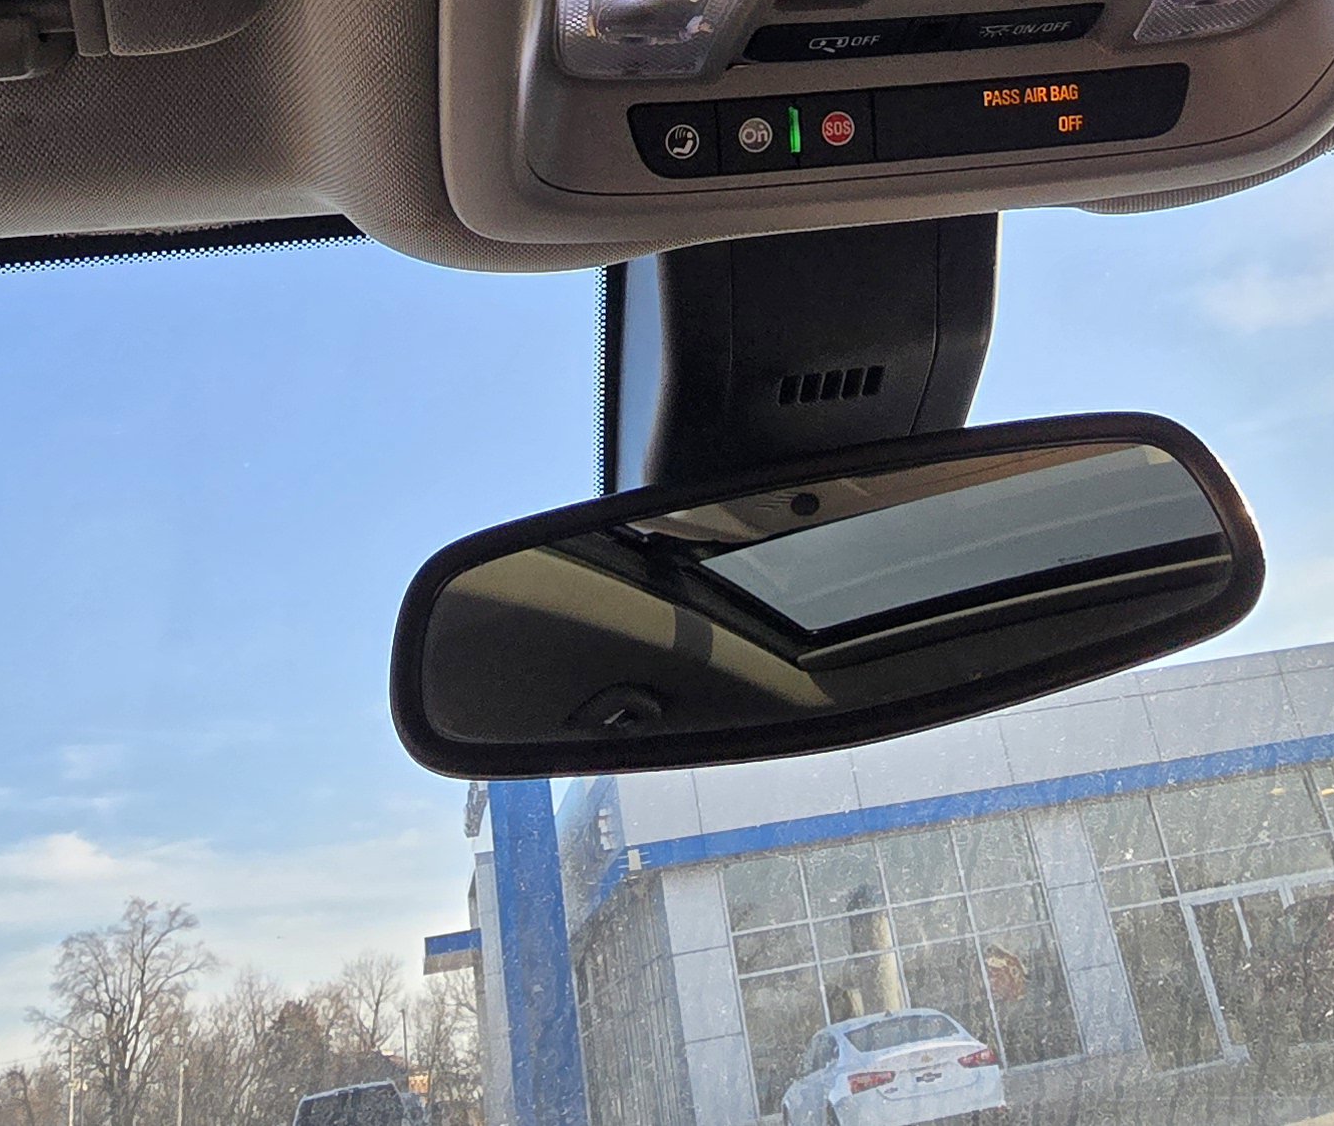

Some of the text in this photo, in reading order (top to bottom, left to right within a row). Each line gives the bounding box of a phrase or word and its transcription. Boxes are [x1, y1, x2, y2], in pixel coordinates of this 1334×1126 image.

[1012, 21, 1071, 35] ON/OFF
[851, 34, 880, 47] OFF
[983, 84, 1079, 107] PASS AIR BAG
[825, 121, 852, 136] SOS
[1058, 115, 1083, 132] OFF
